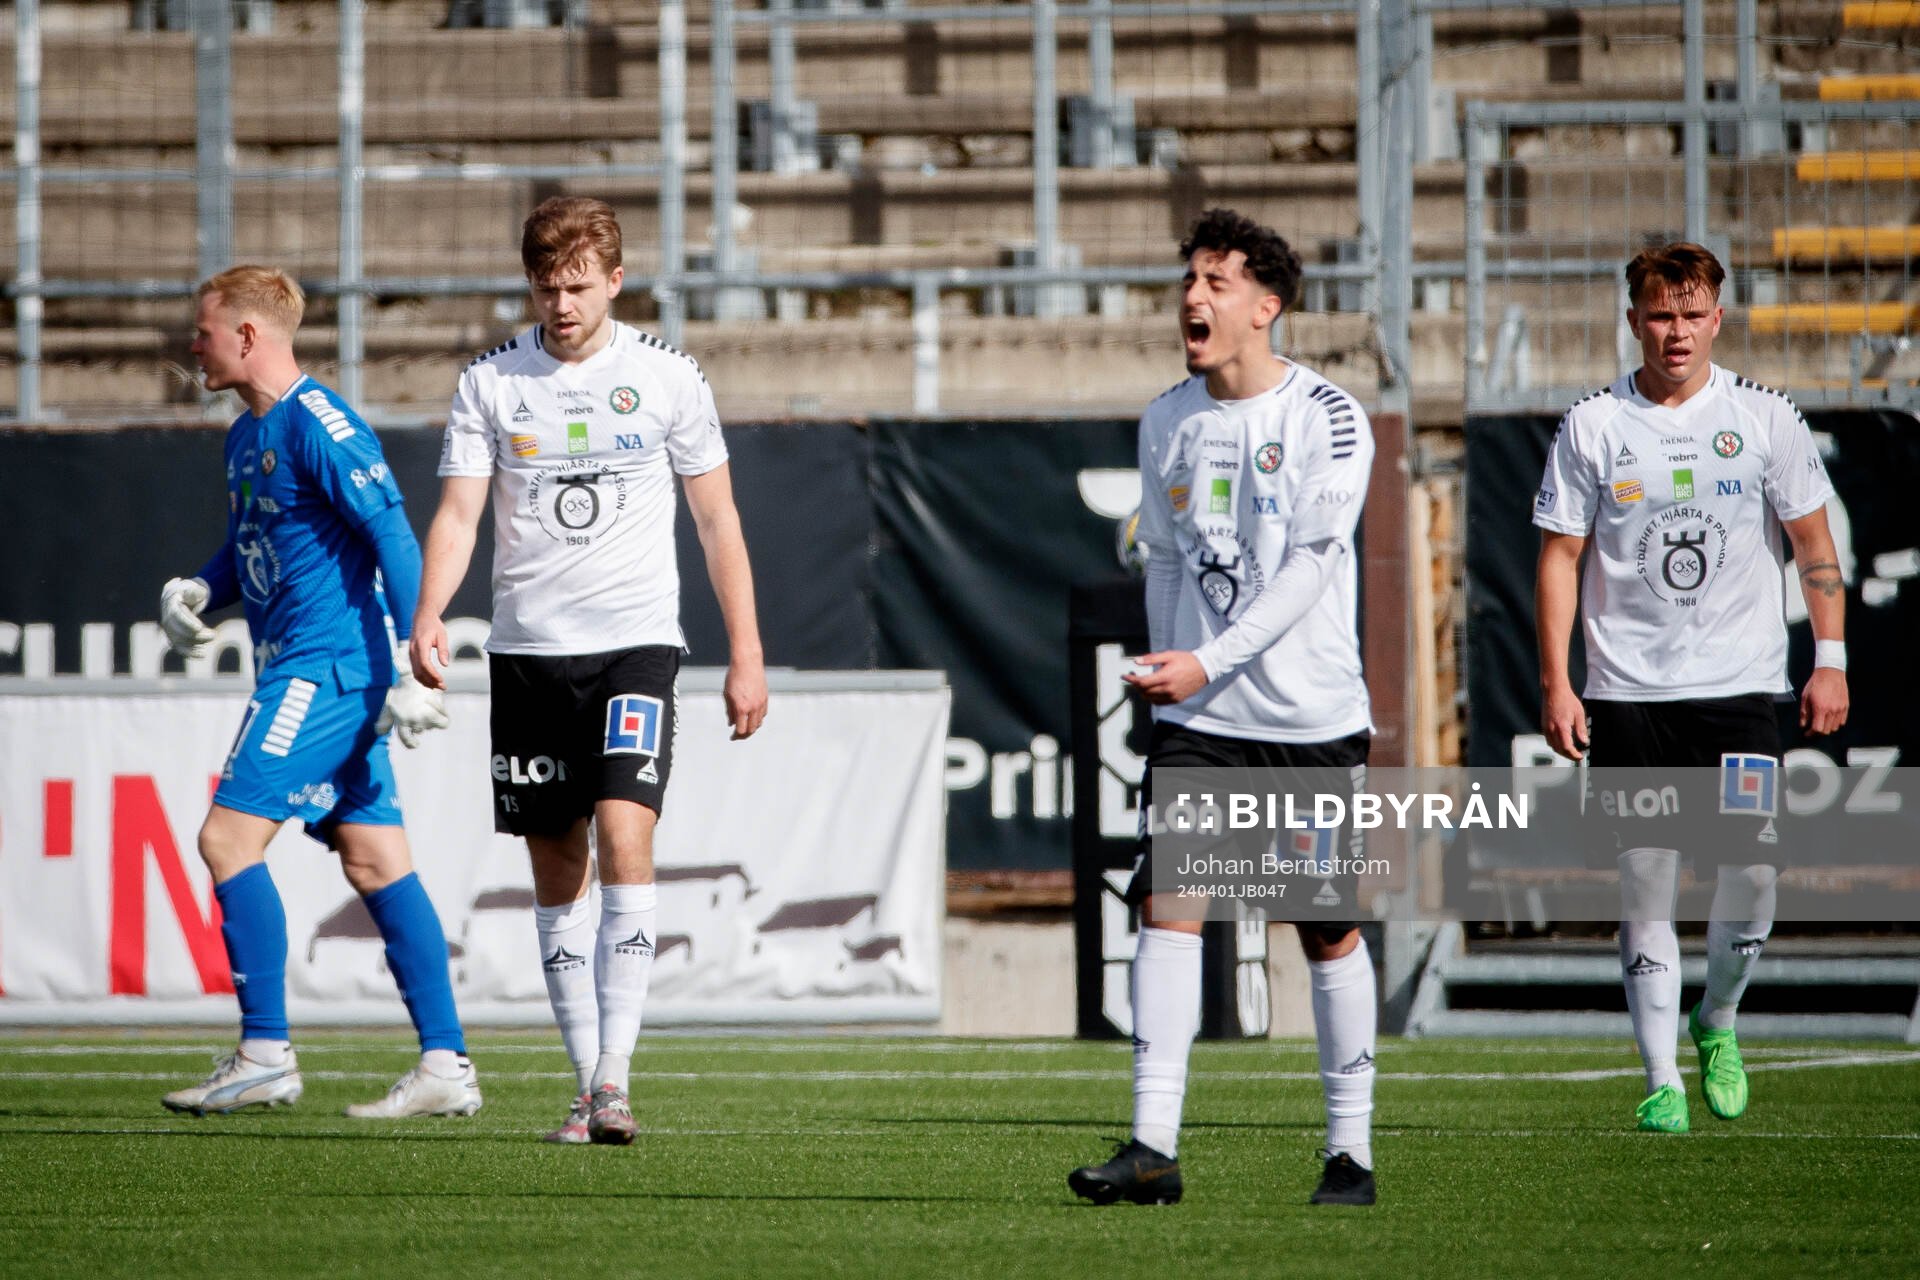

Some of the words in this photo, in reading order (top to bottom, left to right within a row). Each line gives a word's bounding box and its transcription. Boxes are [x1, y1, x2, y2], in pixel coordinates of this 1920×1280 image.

[615, 434, 643, 450] NA
[1716, 480, 1742, 496] NA
[1253, 496, 1280, 514] NA
[1660, 506, 1703, 523] HJÄRTA
[1705, 514, 1714, 524] &
[566, 536, 590, 546] 1908
[1674, 597, 1697, 607] 1908
